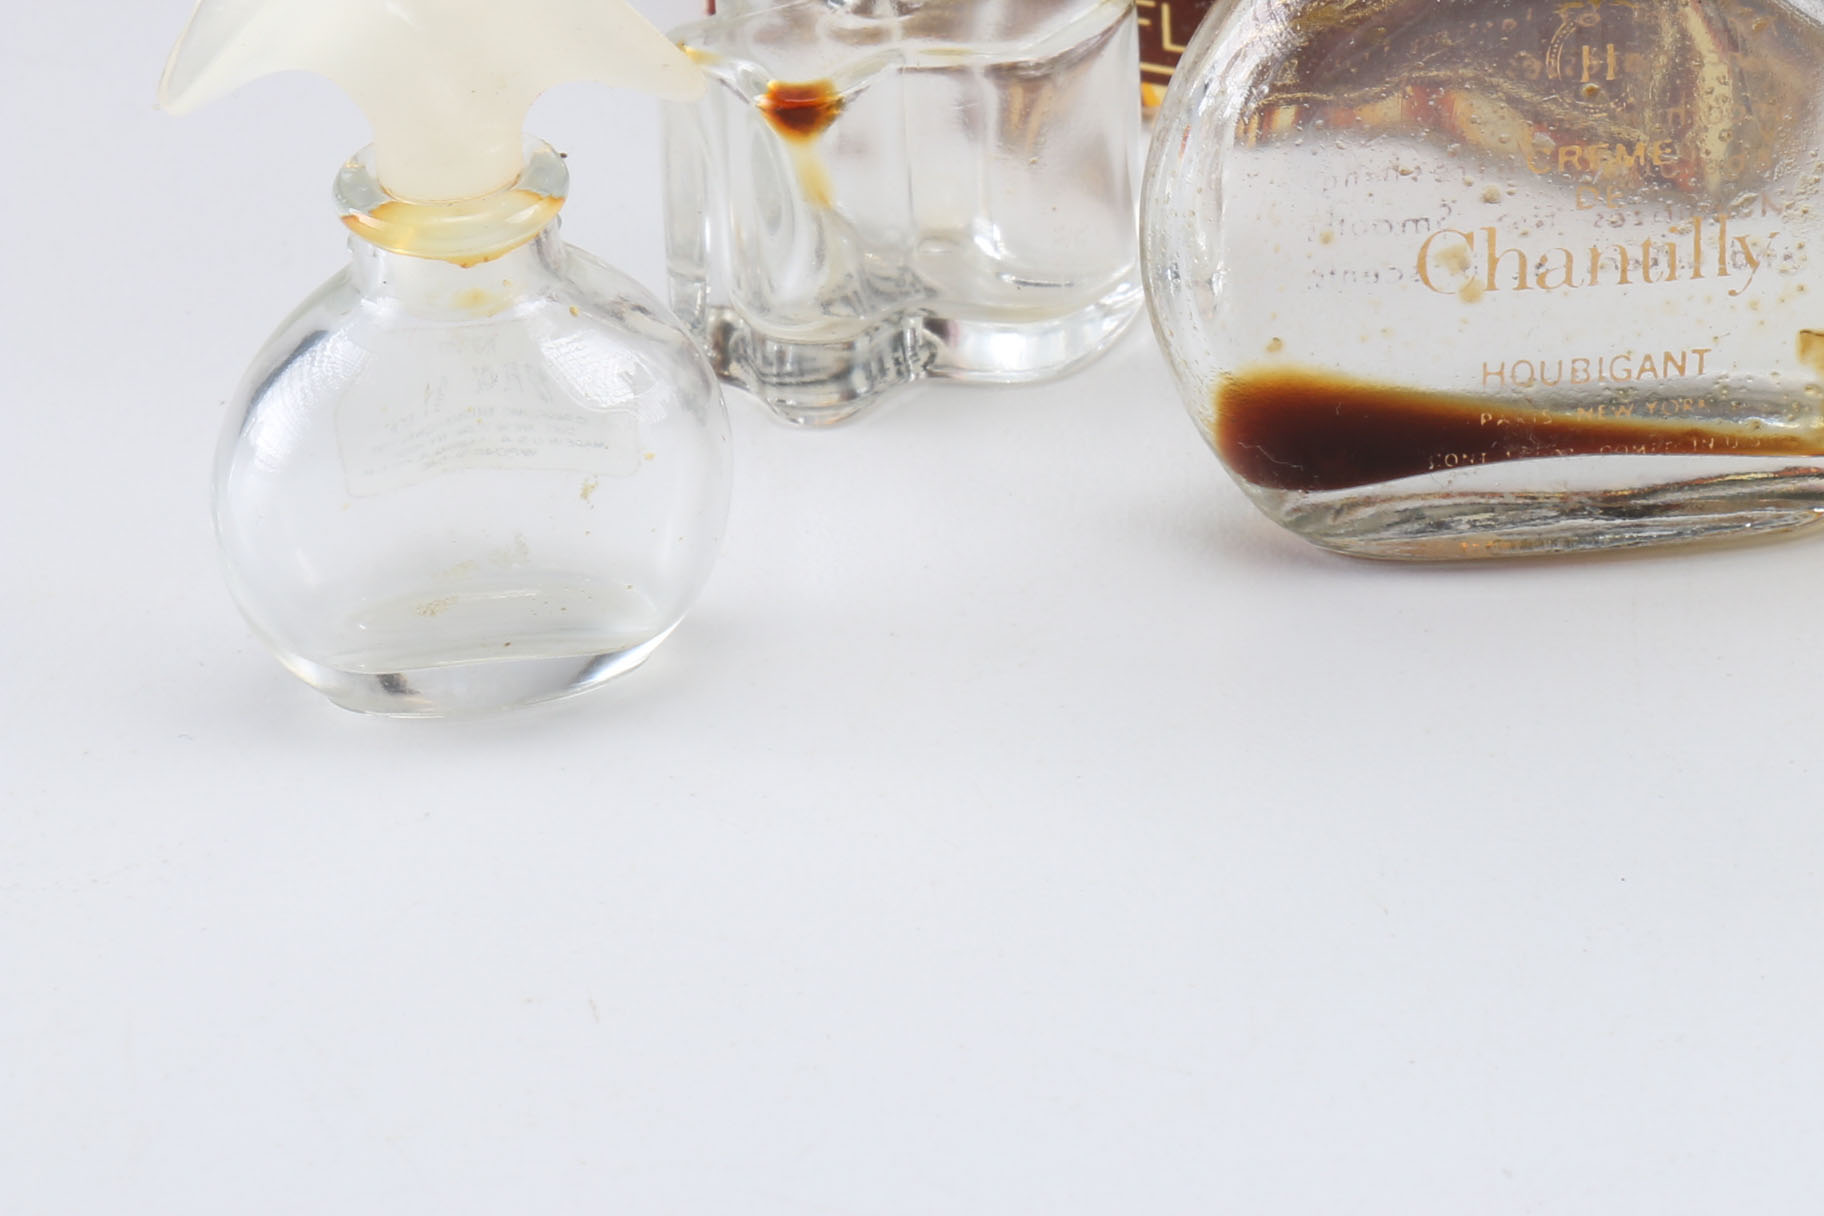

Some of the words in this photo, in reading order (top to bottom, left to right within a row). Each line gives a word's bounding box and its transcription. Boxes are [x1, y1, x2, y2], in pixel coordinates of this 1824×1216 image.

[1575, 184, 1625, 212] DE
[1415, 212, 1781, 297] Chantilly
[1481, 347, 1713, 388] HOUBIGANT
